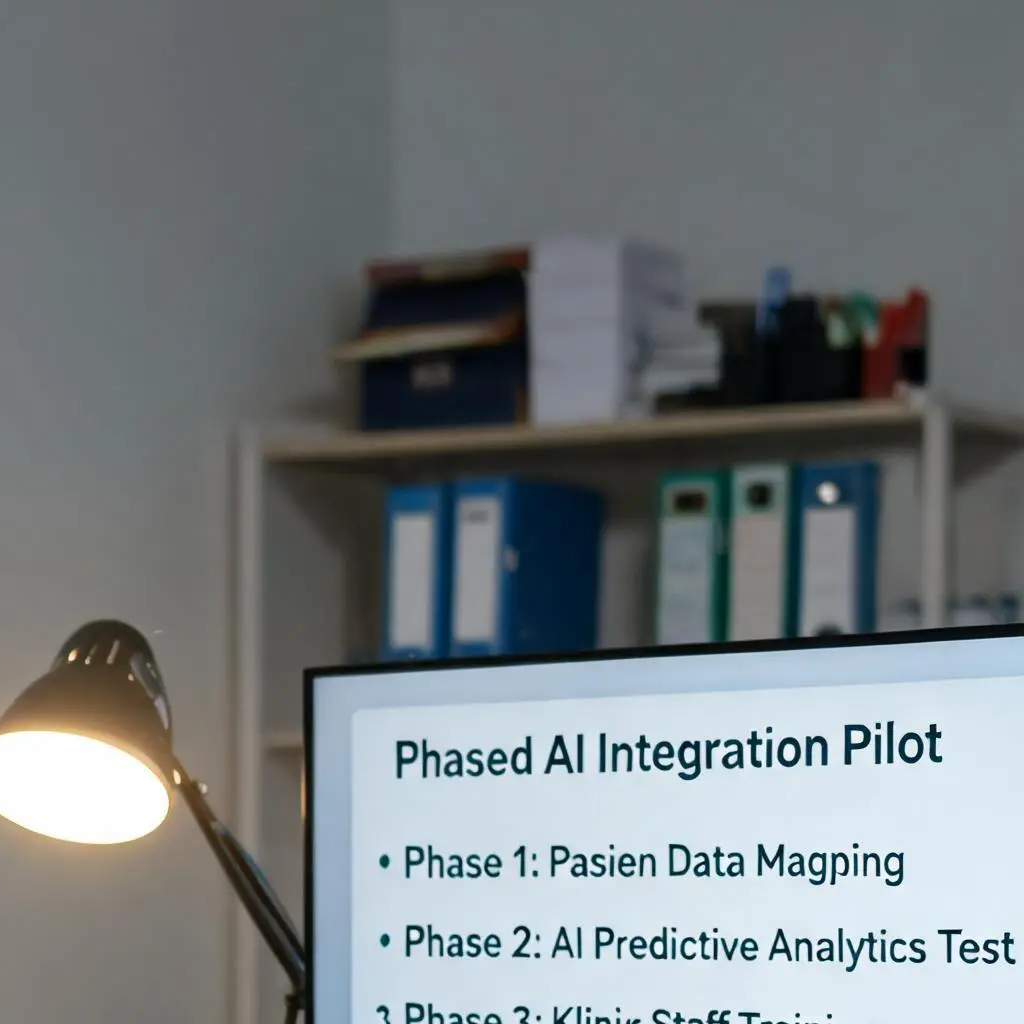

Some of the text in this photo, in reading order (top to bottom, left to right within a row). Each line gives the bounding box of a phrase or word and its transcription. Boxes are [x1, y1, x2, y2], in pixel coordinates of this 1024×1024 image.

[396, 721, 943, 780] Phased AI Integration Pilot
[405, 842, 905, 887] Phase 1: Pasien Data Magping
[405, 924, 1016, 972] Phase 2: AI Predictive Analytics Test
